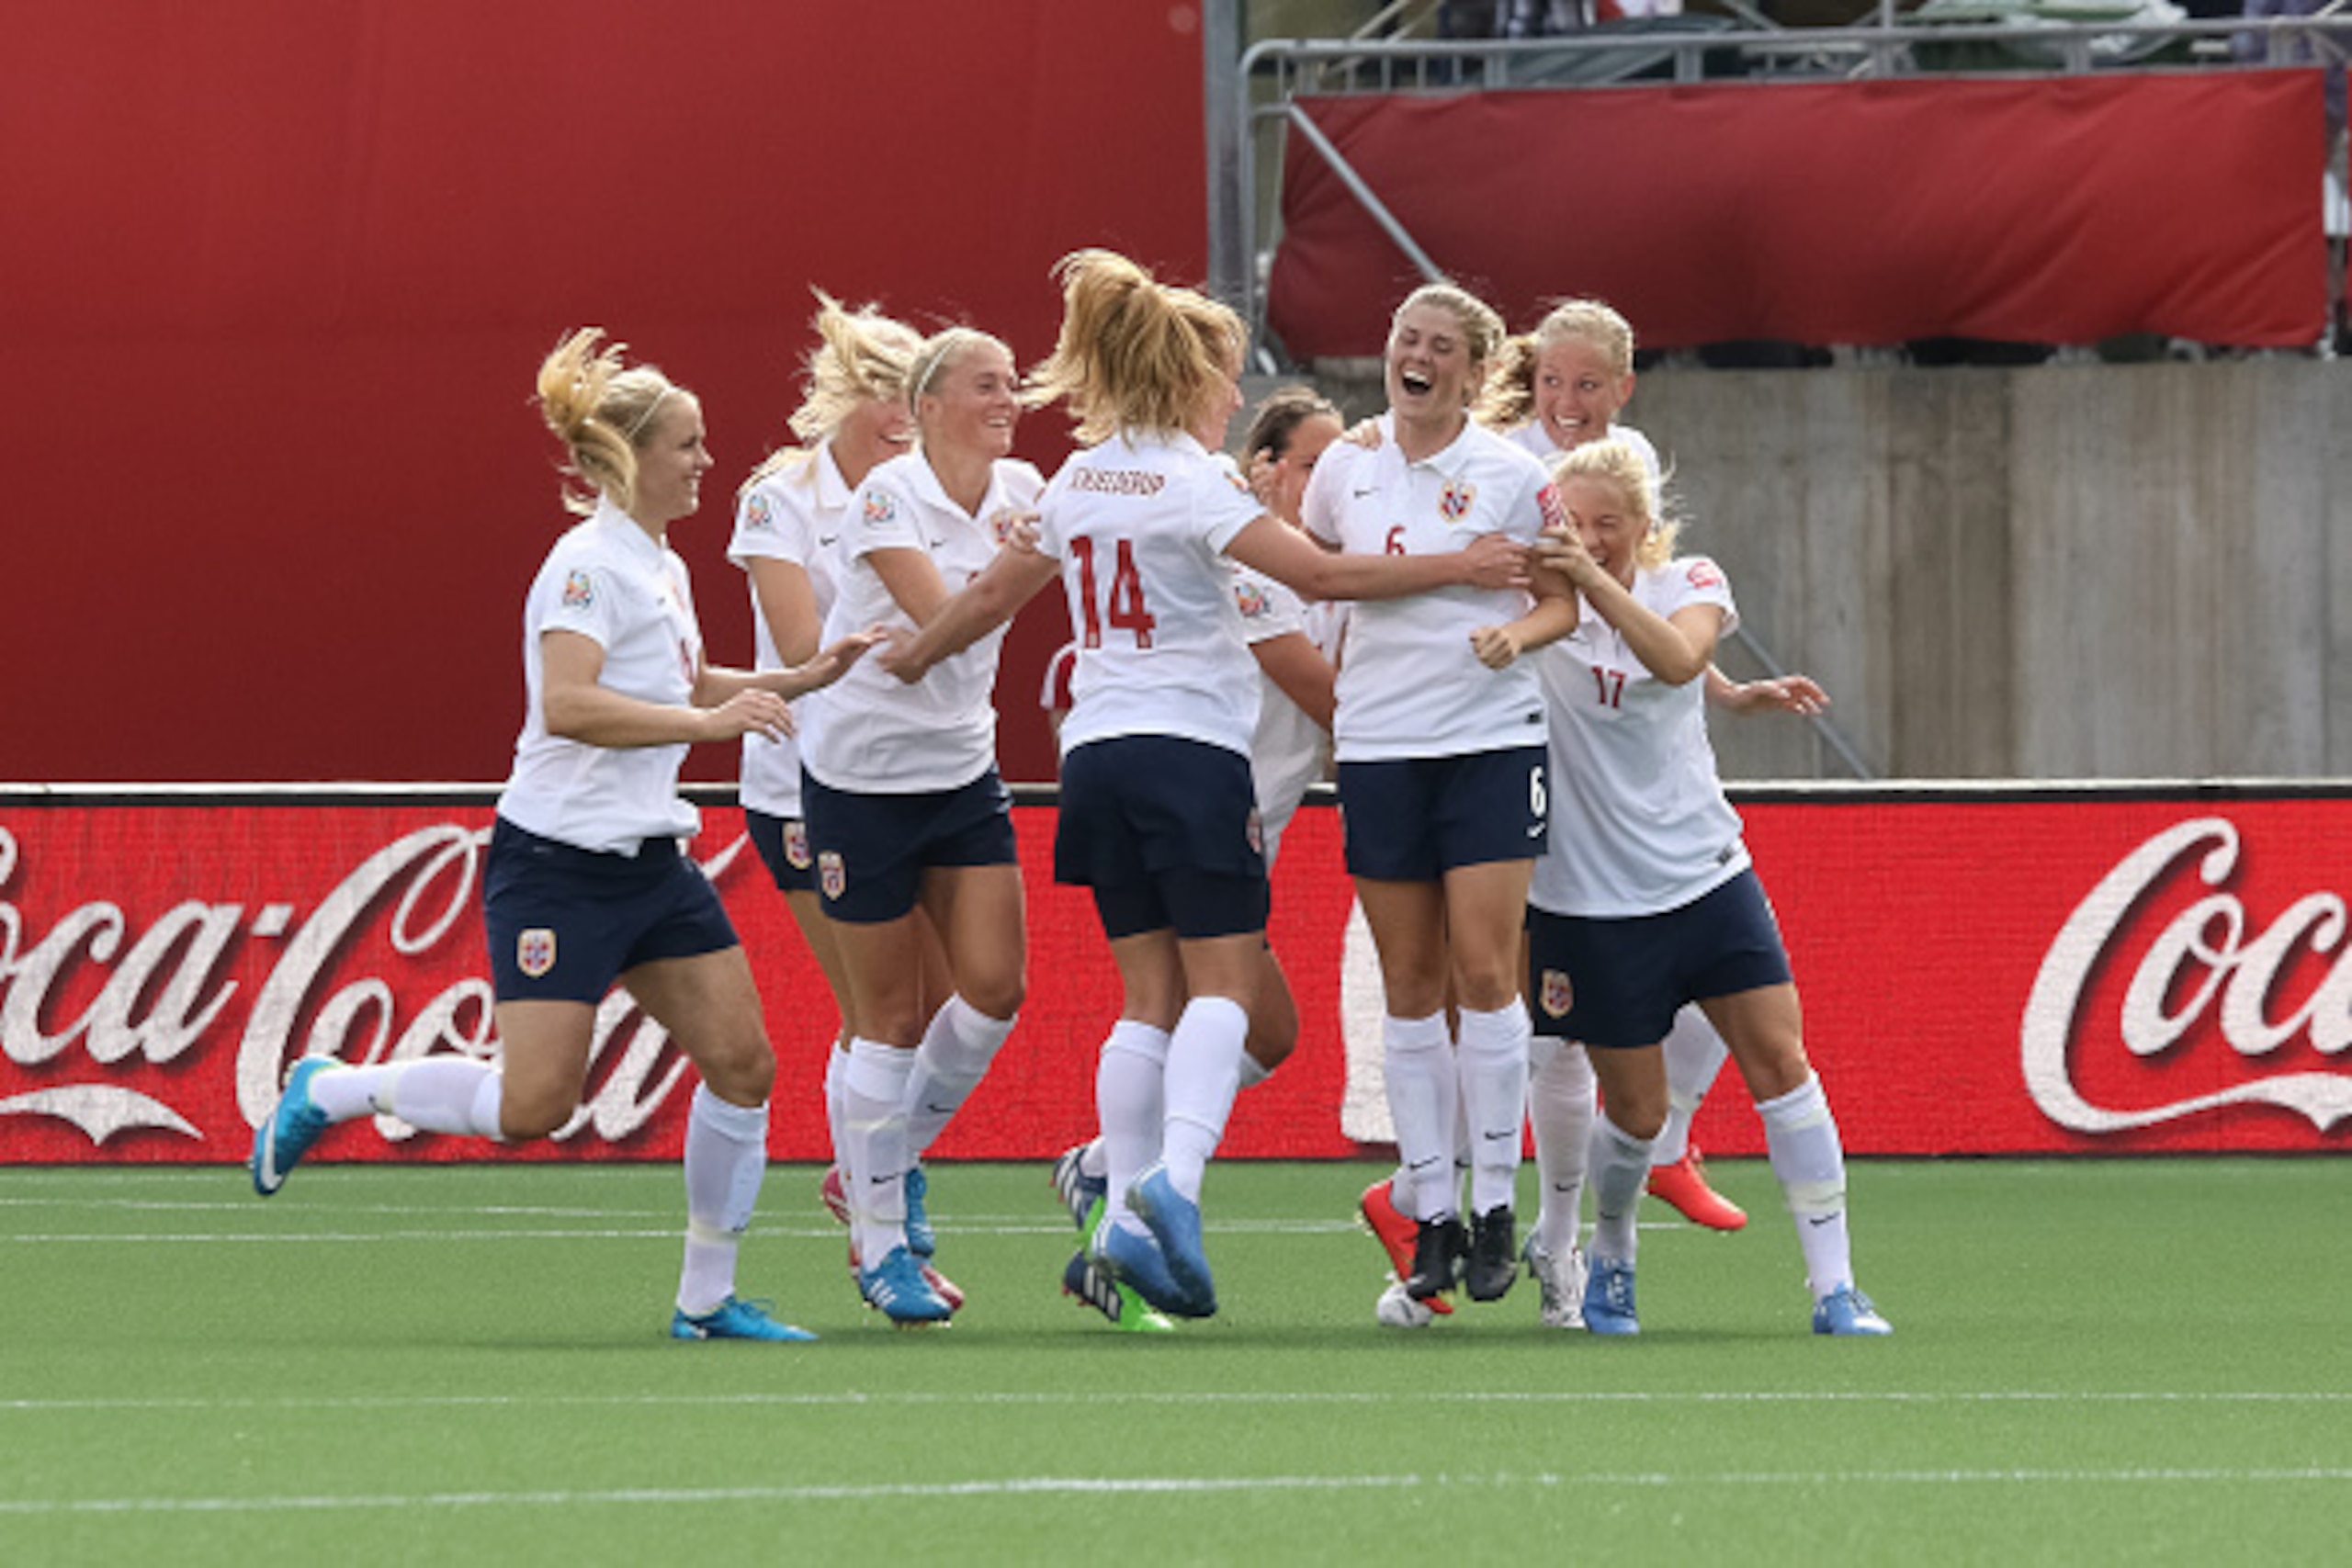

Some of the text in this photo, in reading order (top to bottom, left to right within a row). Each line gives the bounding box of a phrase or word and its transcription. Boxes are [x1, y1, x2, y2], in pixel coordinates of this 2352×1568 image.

[1385, 525, 1407, 556] 6
[1069, 535, 1156, 649] 14
[1590, 665, 1626, 709] 17
[1530, 765, 1547, 818] 6
